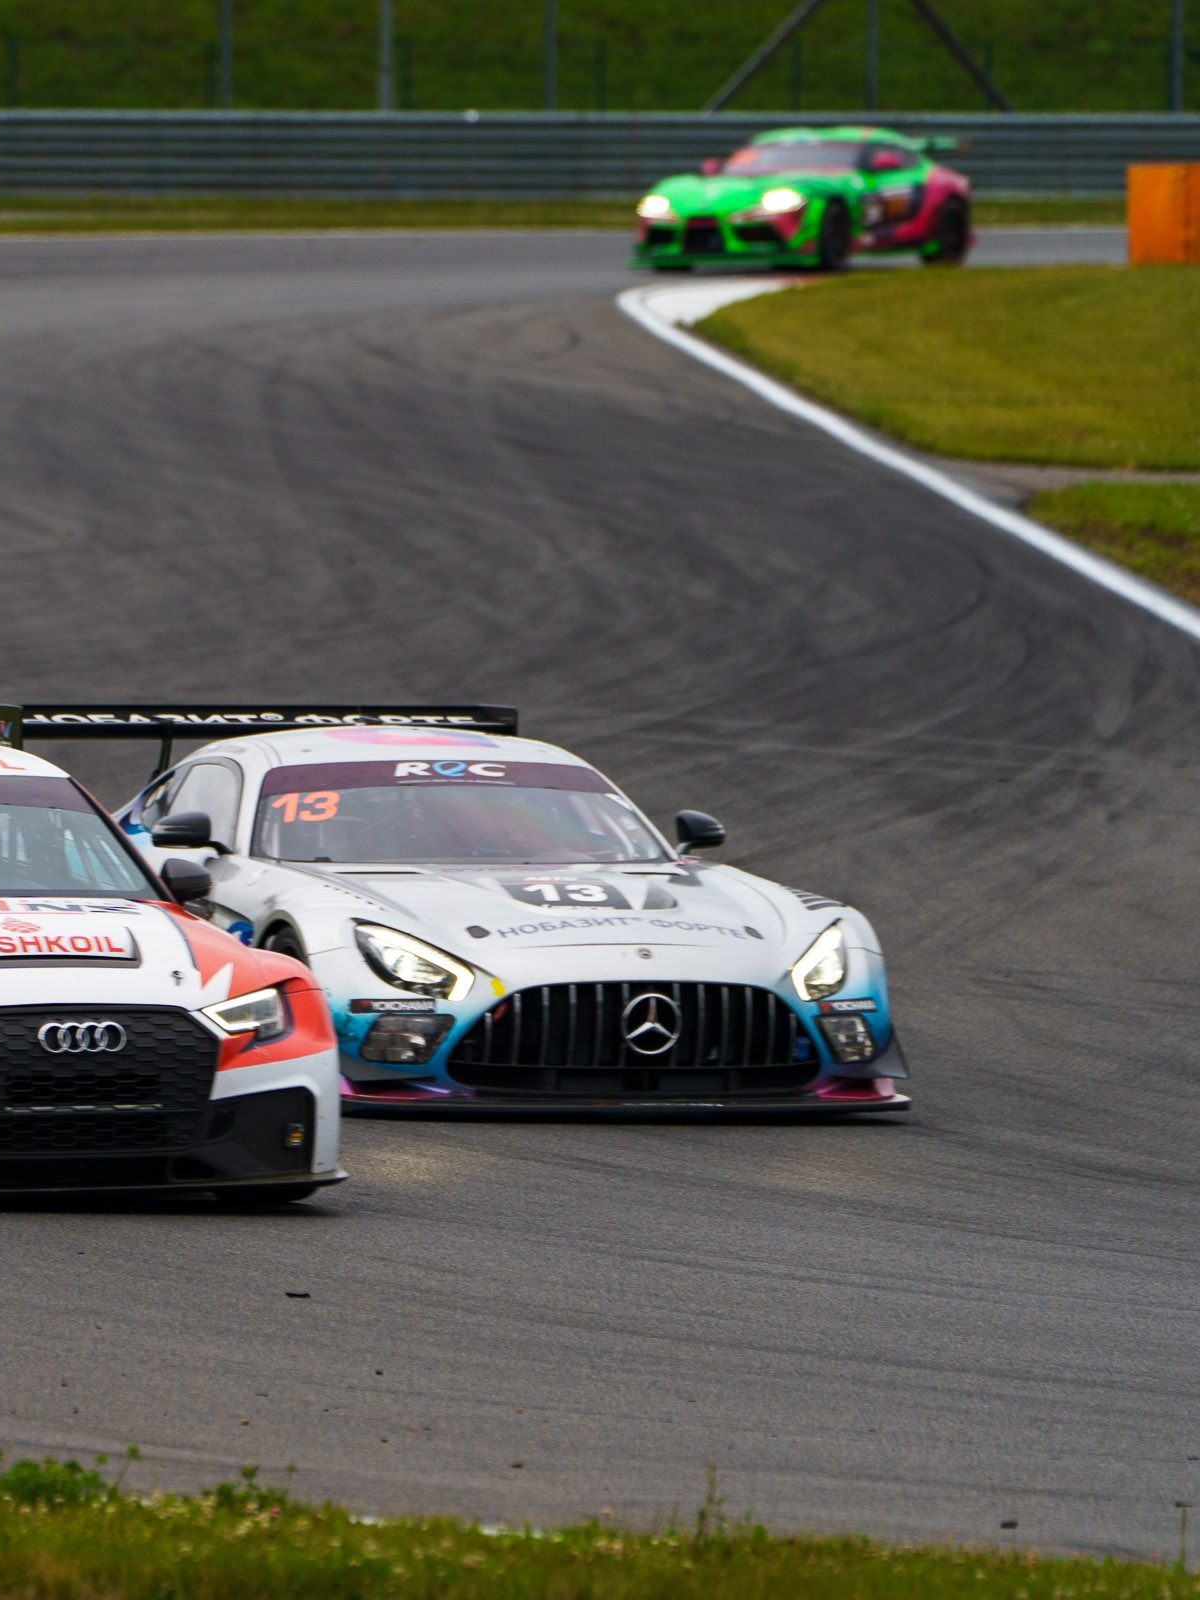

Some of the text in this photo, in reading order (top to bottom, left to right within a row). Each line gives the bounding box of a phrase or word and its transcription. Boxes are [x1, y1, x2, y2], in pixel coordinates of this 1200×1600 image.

[271, 790, 340, 823] 13
[523, 884, 608, 902] 13
[648, 919, 748, 939] ФОРТЕ
